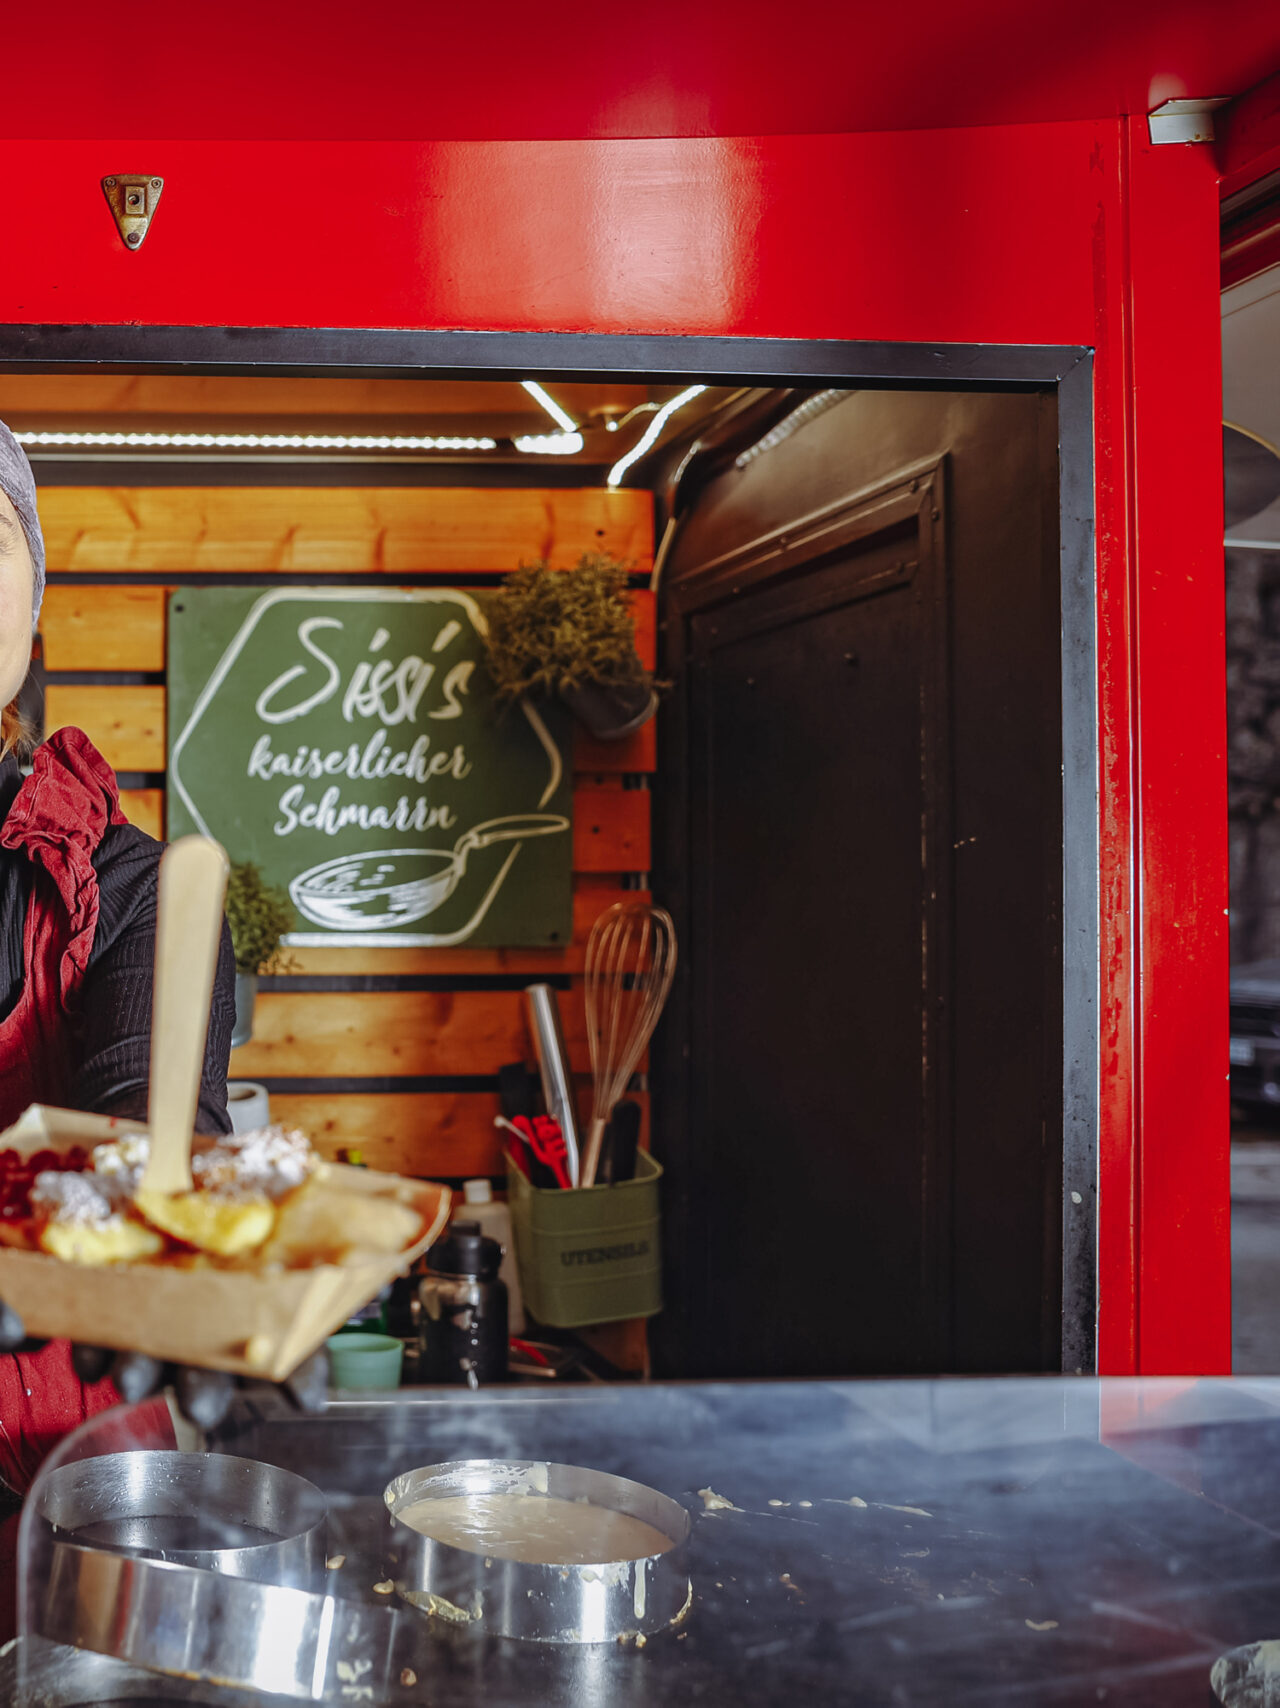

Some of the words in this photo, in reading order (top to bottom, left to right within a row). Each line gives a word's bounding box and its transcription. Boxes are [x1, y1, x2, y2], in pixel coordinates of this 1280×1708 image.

[256, 616, 476, 726] Sissi's
[247, 728, 472, 783] kaiserlicher
[273, 784, 458, 836] Schmarrn
